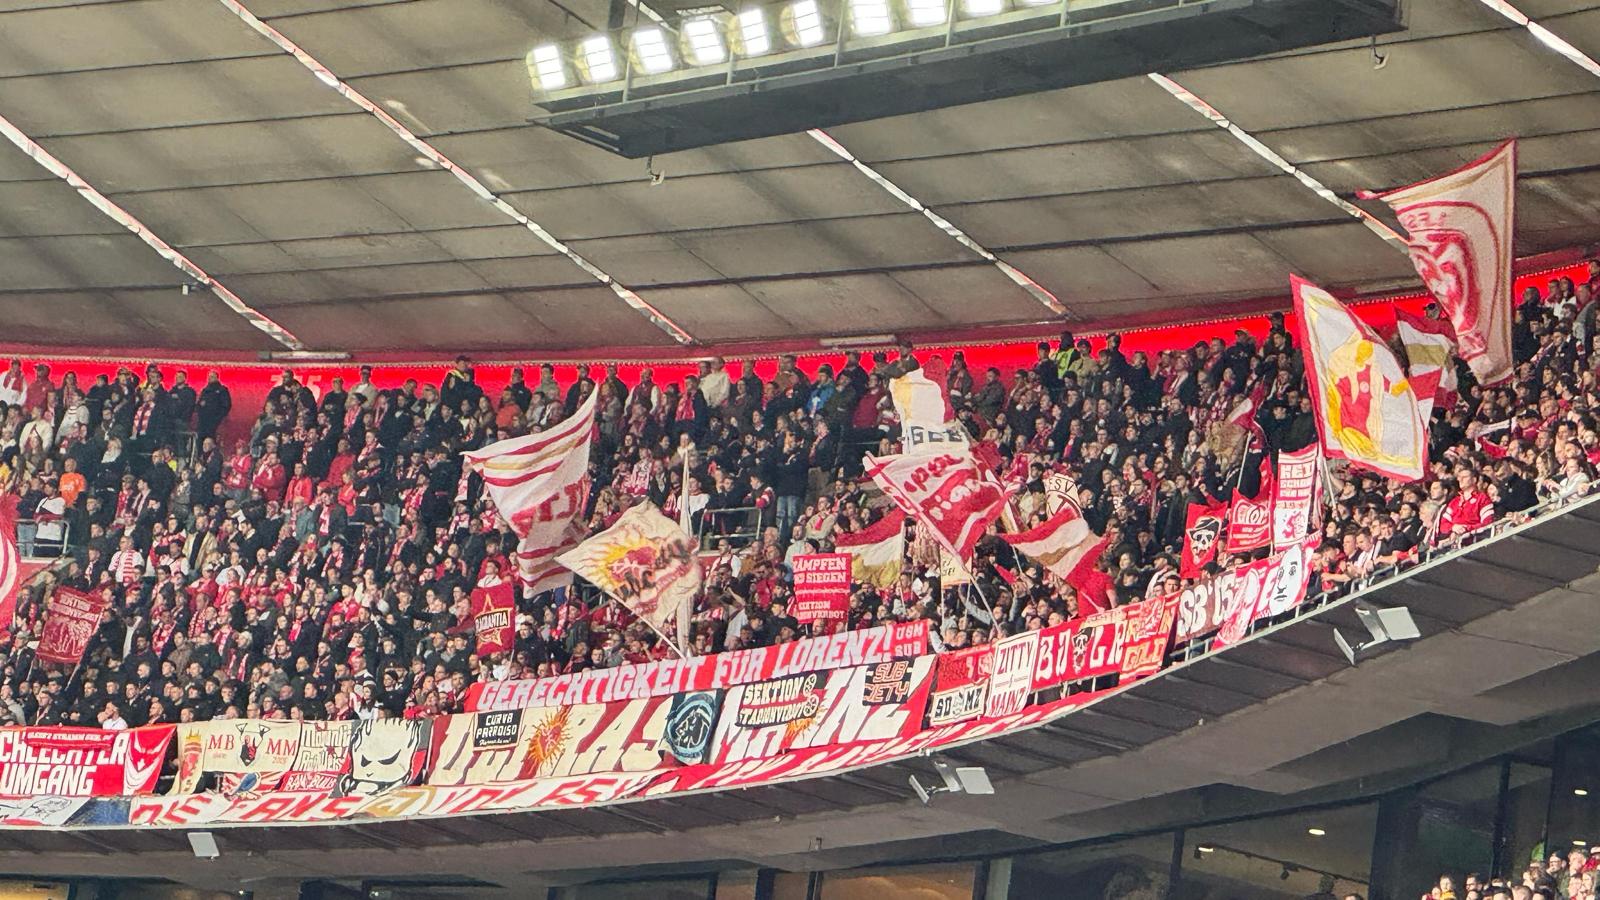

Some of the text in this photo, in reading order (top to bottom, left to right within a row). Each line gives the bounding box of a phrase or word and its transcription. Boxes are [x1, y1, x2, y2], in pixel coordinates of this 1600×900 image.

[476, 658, 705, 711] GERECHTIGKEIT
[711, 650, 762, 687] FÜR
[770, 624, 893, 678] LORENZ!
[873, 661, 909, 683] SUB
[743, 677, 805, 705] SEKTION
[485, 713, 514, 726] CURVA
[208, 734, 235, 750] MB
[266, 738, 297, 756] MM
[0, 762, 97, 796] UMGANG
